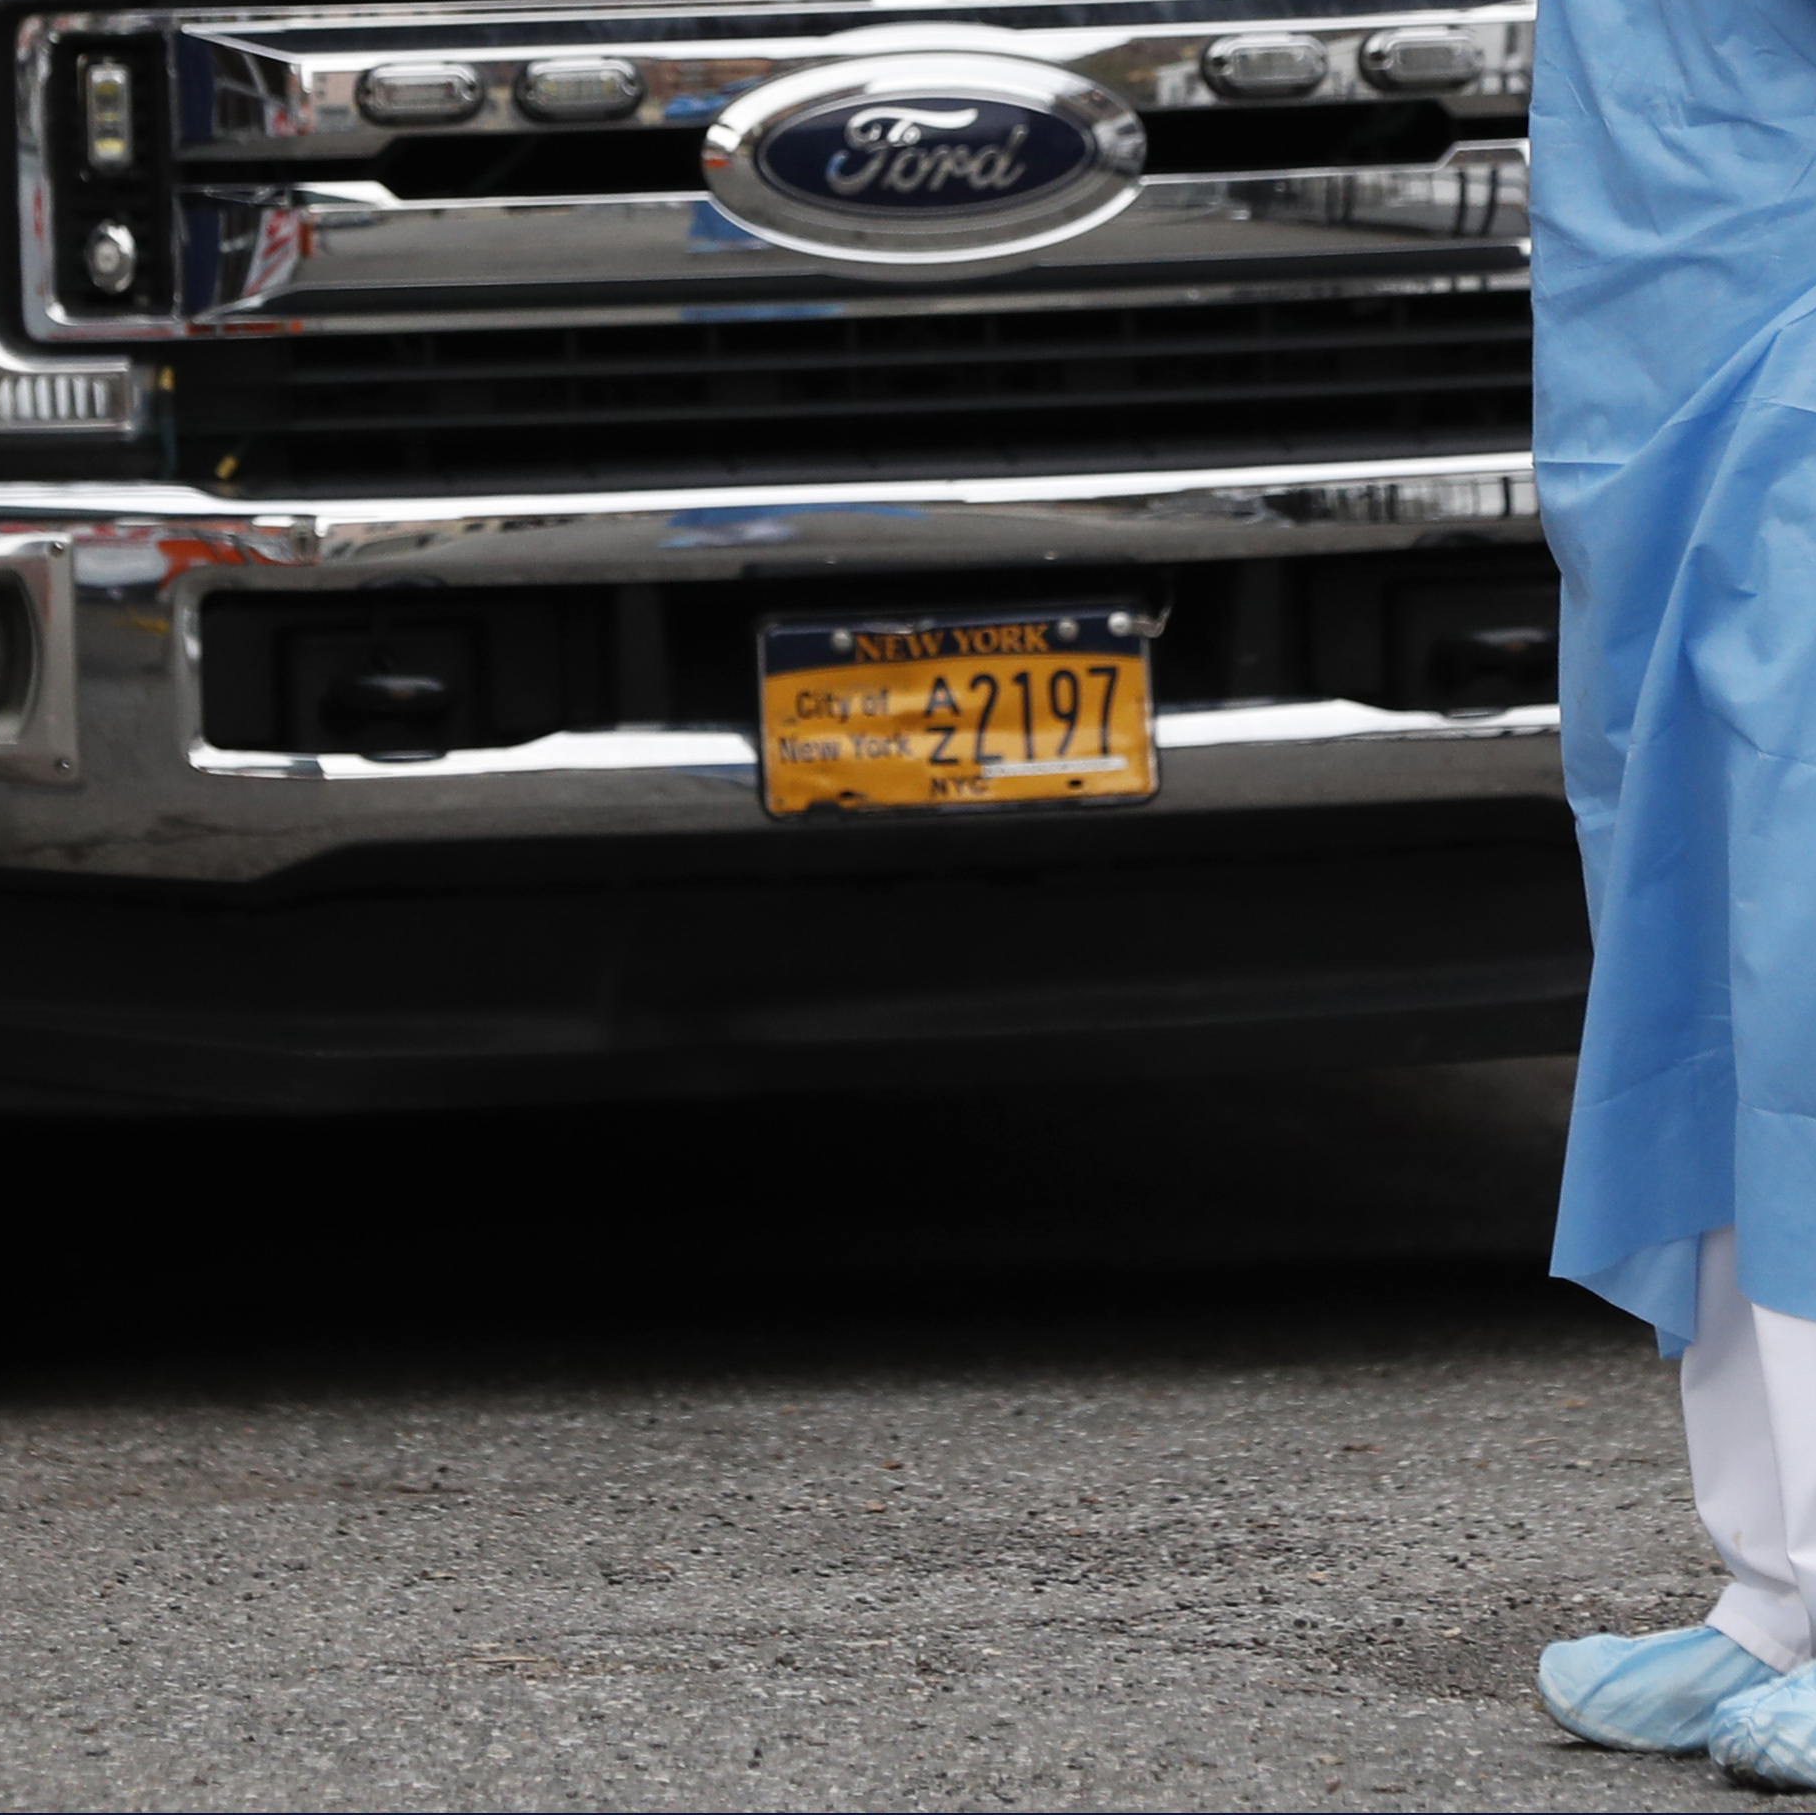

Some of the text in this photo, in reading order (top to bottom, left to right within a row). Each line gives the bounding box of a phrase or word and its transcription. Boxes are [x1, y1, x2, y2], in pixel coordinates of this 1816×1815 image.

[824, 105, 1029, 194] Ford
[854, 623, 1051, 665] NEW YORK
[796, 688, 889, 722] City of
[970, 666, 1119, 766] 2197
[779, 732, 913, 764] New York
